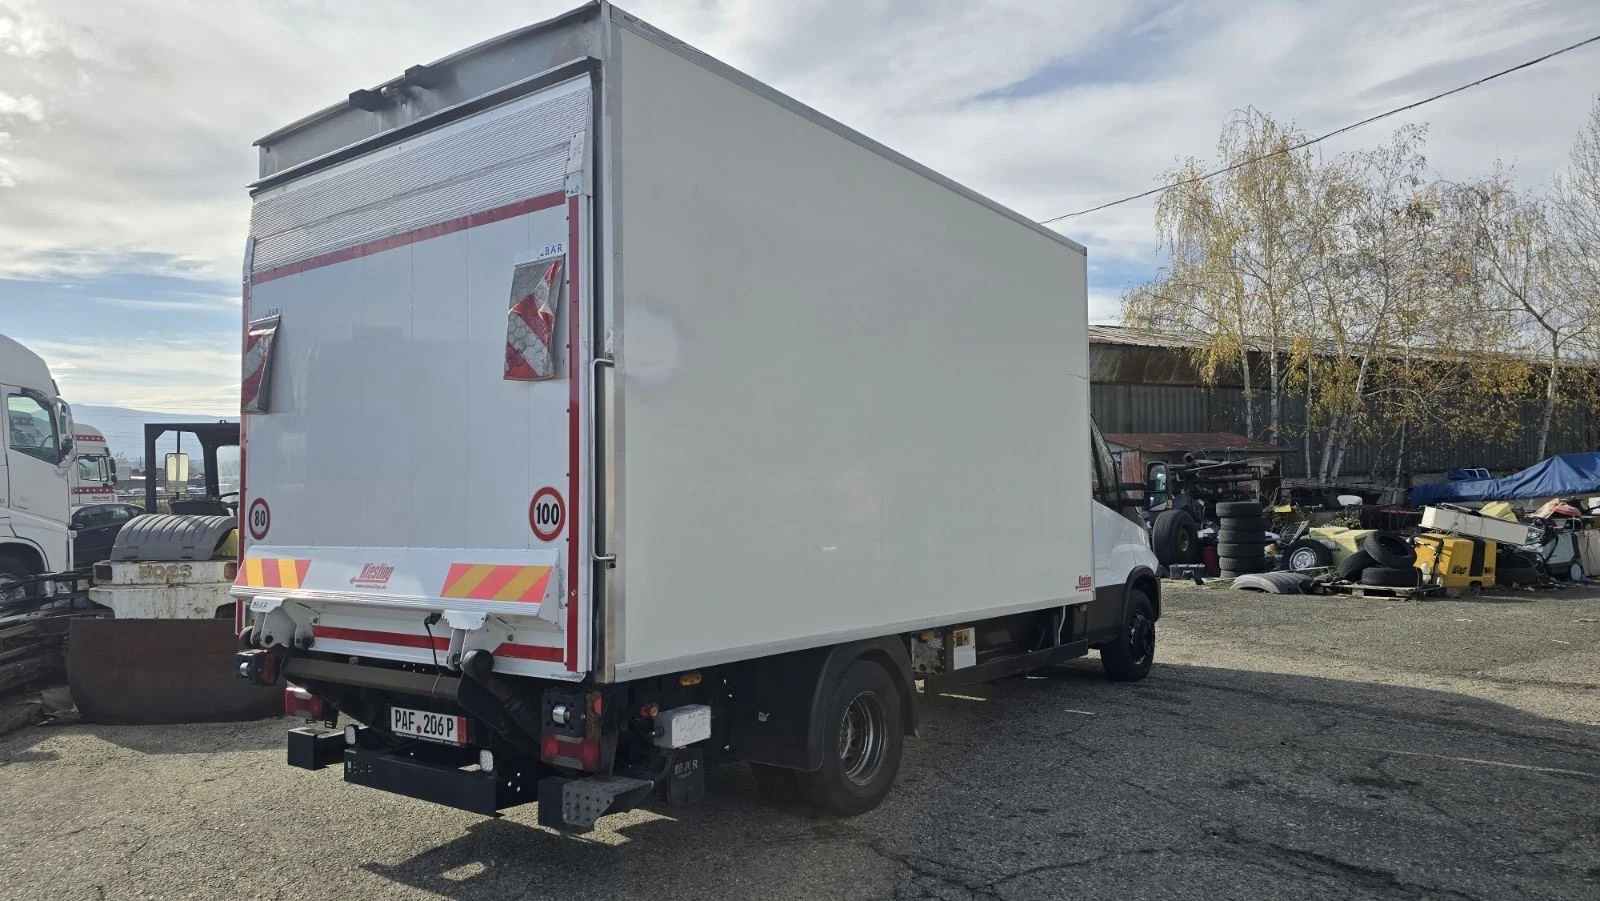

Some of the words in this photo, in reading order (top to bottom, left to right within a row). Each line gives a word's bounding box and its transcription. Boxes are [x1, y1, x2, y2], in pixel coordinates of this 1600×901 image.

[255, 510, 266, 527] 80
[536, 502, 560, 525] 100
[395, 709, 415, 731] PAF
[423, 714, 444, 736] 206
[446, 717, 454, 737] P
